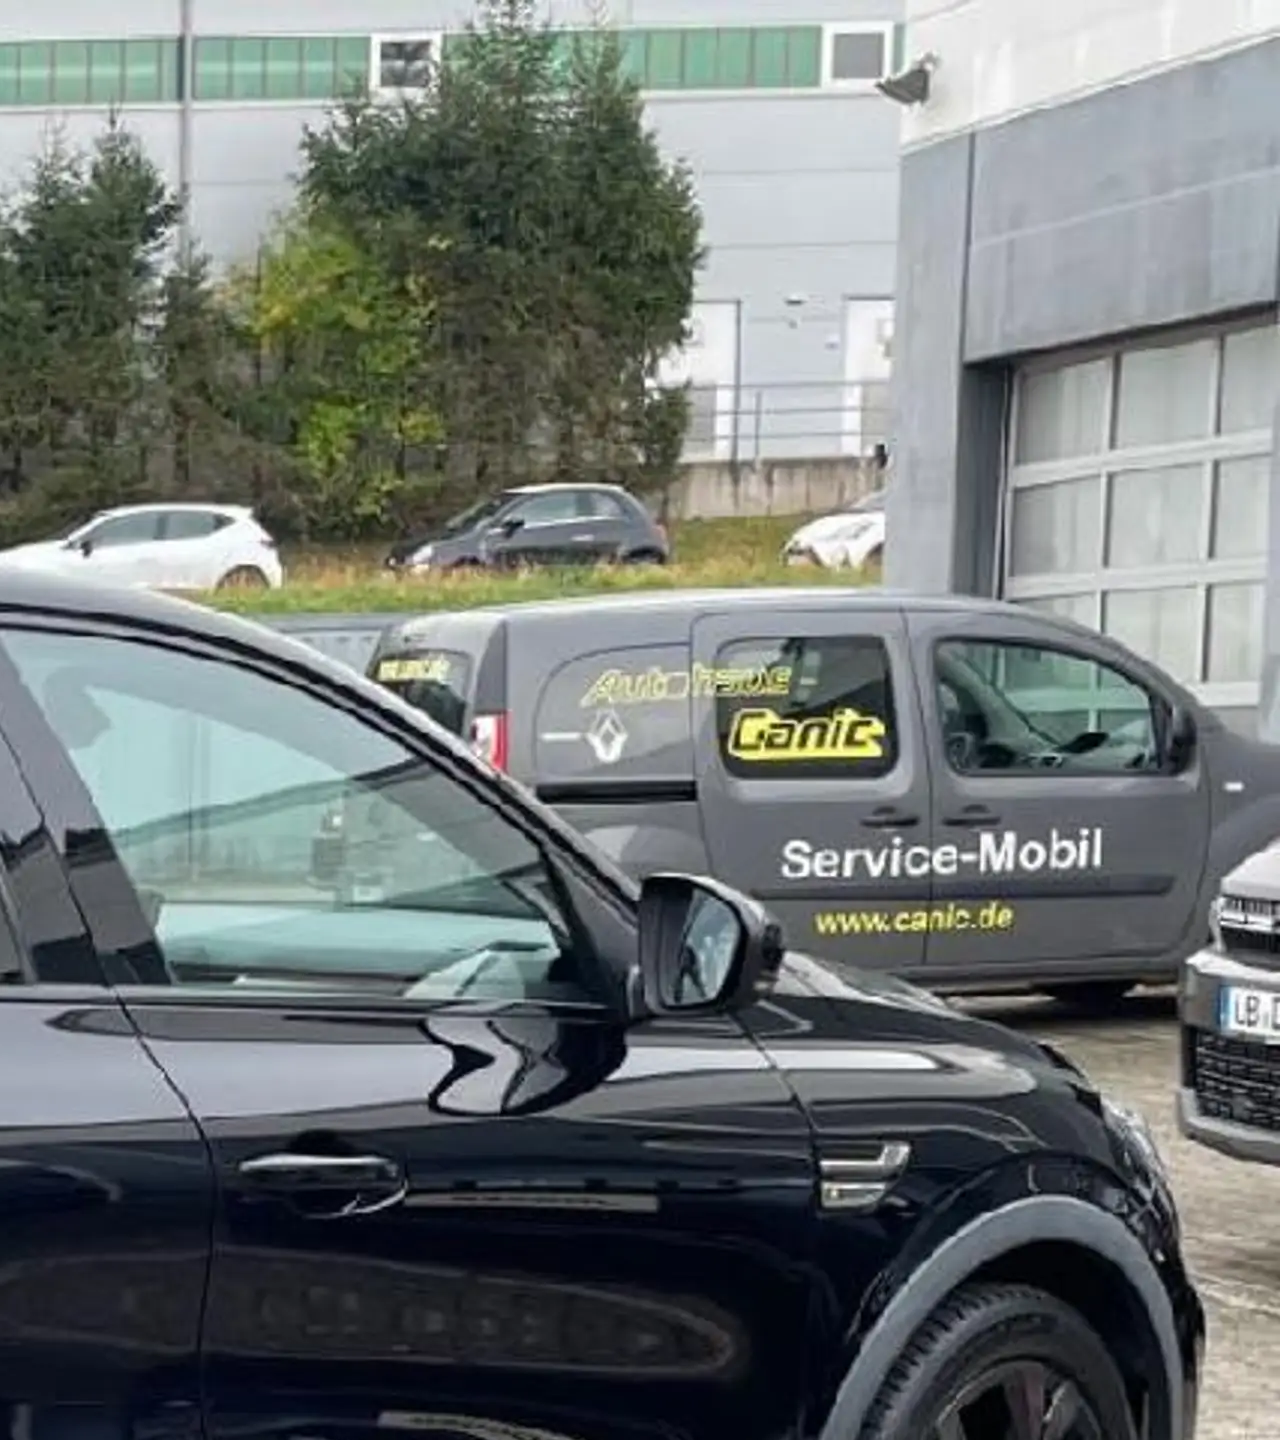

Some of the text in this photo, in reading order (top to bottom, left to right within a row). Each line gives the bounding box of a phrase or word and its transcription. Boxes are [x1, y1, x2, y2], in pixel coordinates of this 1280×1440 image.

[729, 707, 885, 759] Canic
[781, 828, 1103, 878] Service-Mobil
[815, 902, 1014, 934] www.canic.de
